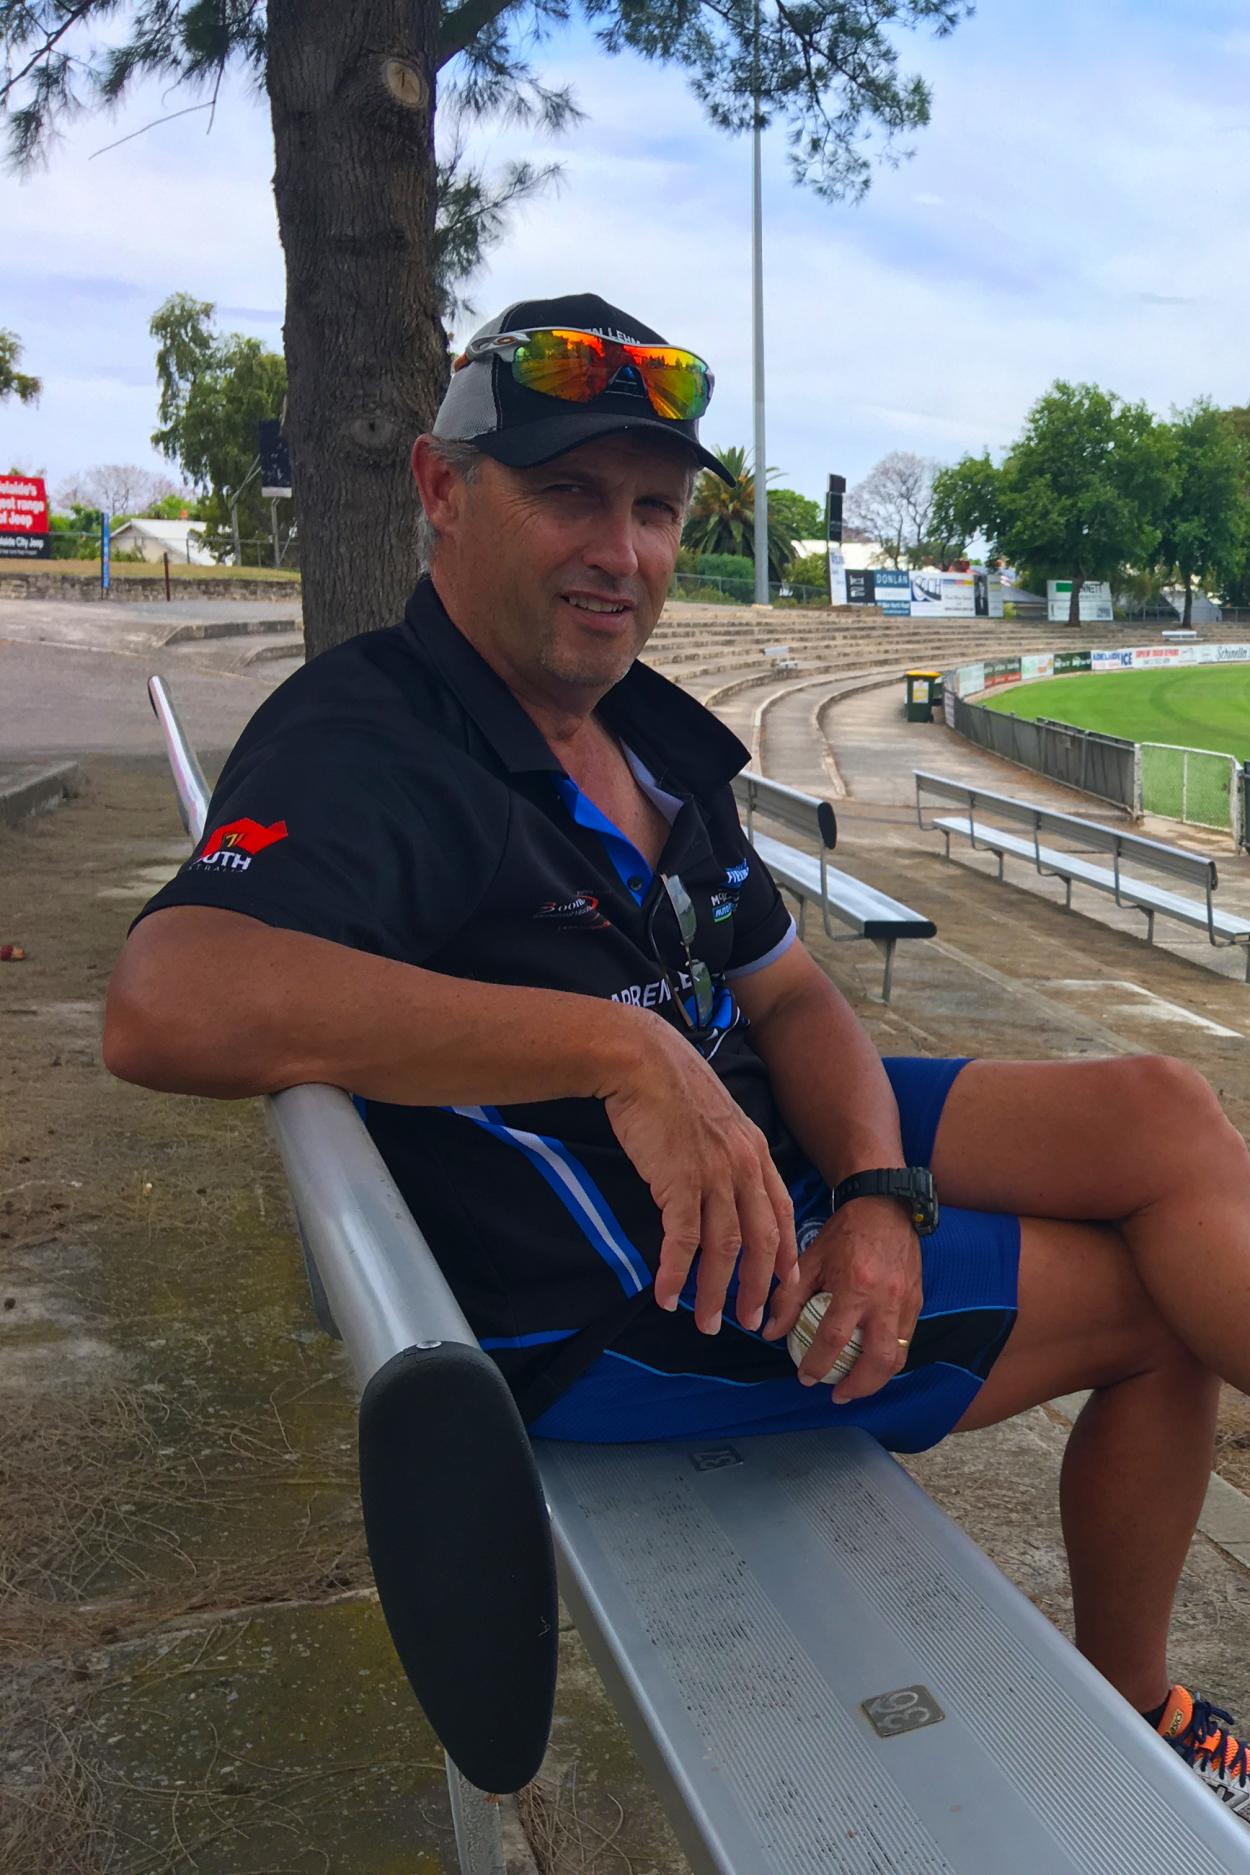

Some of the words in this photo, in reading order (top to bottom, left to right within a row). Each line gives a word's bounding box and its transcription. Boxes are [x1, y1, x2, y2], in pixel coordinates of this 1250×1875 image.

[9, 511, 33, 529] Jeep
[876, 574, 908, 585] DONLAN
[1121, 652, 1132, 666] ICE
[869, 1691, 930, 1729] 36
